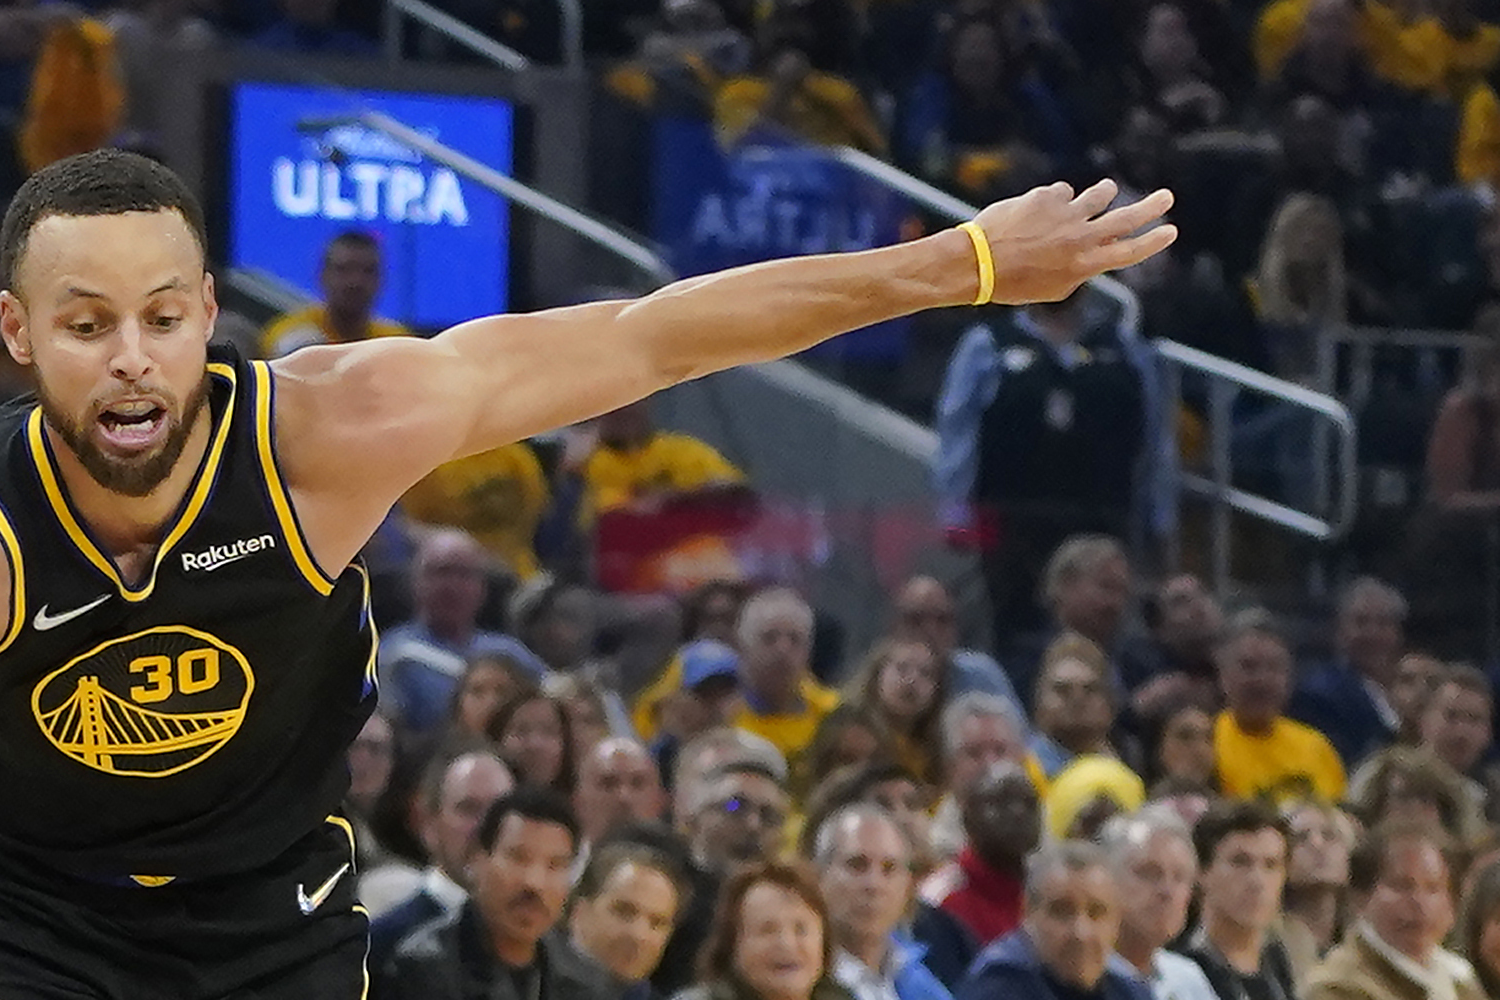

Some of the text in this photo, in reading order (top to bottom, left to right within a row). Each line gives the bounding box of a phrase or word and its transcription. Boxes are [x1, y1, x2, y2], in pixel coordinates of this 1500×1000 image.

[272, 157, 467, 226] ULTRA
[181, 534, 276, 572] Rakuten
[129, 648, 220, 704] 30
